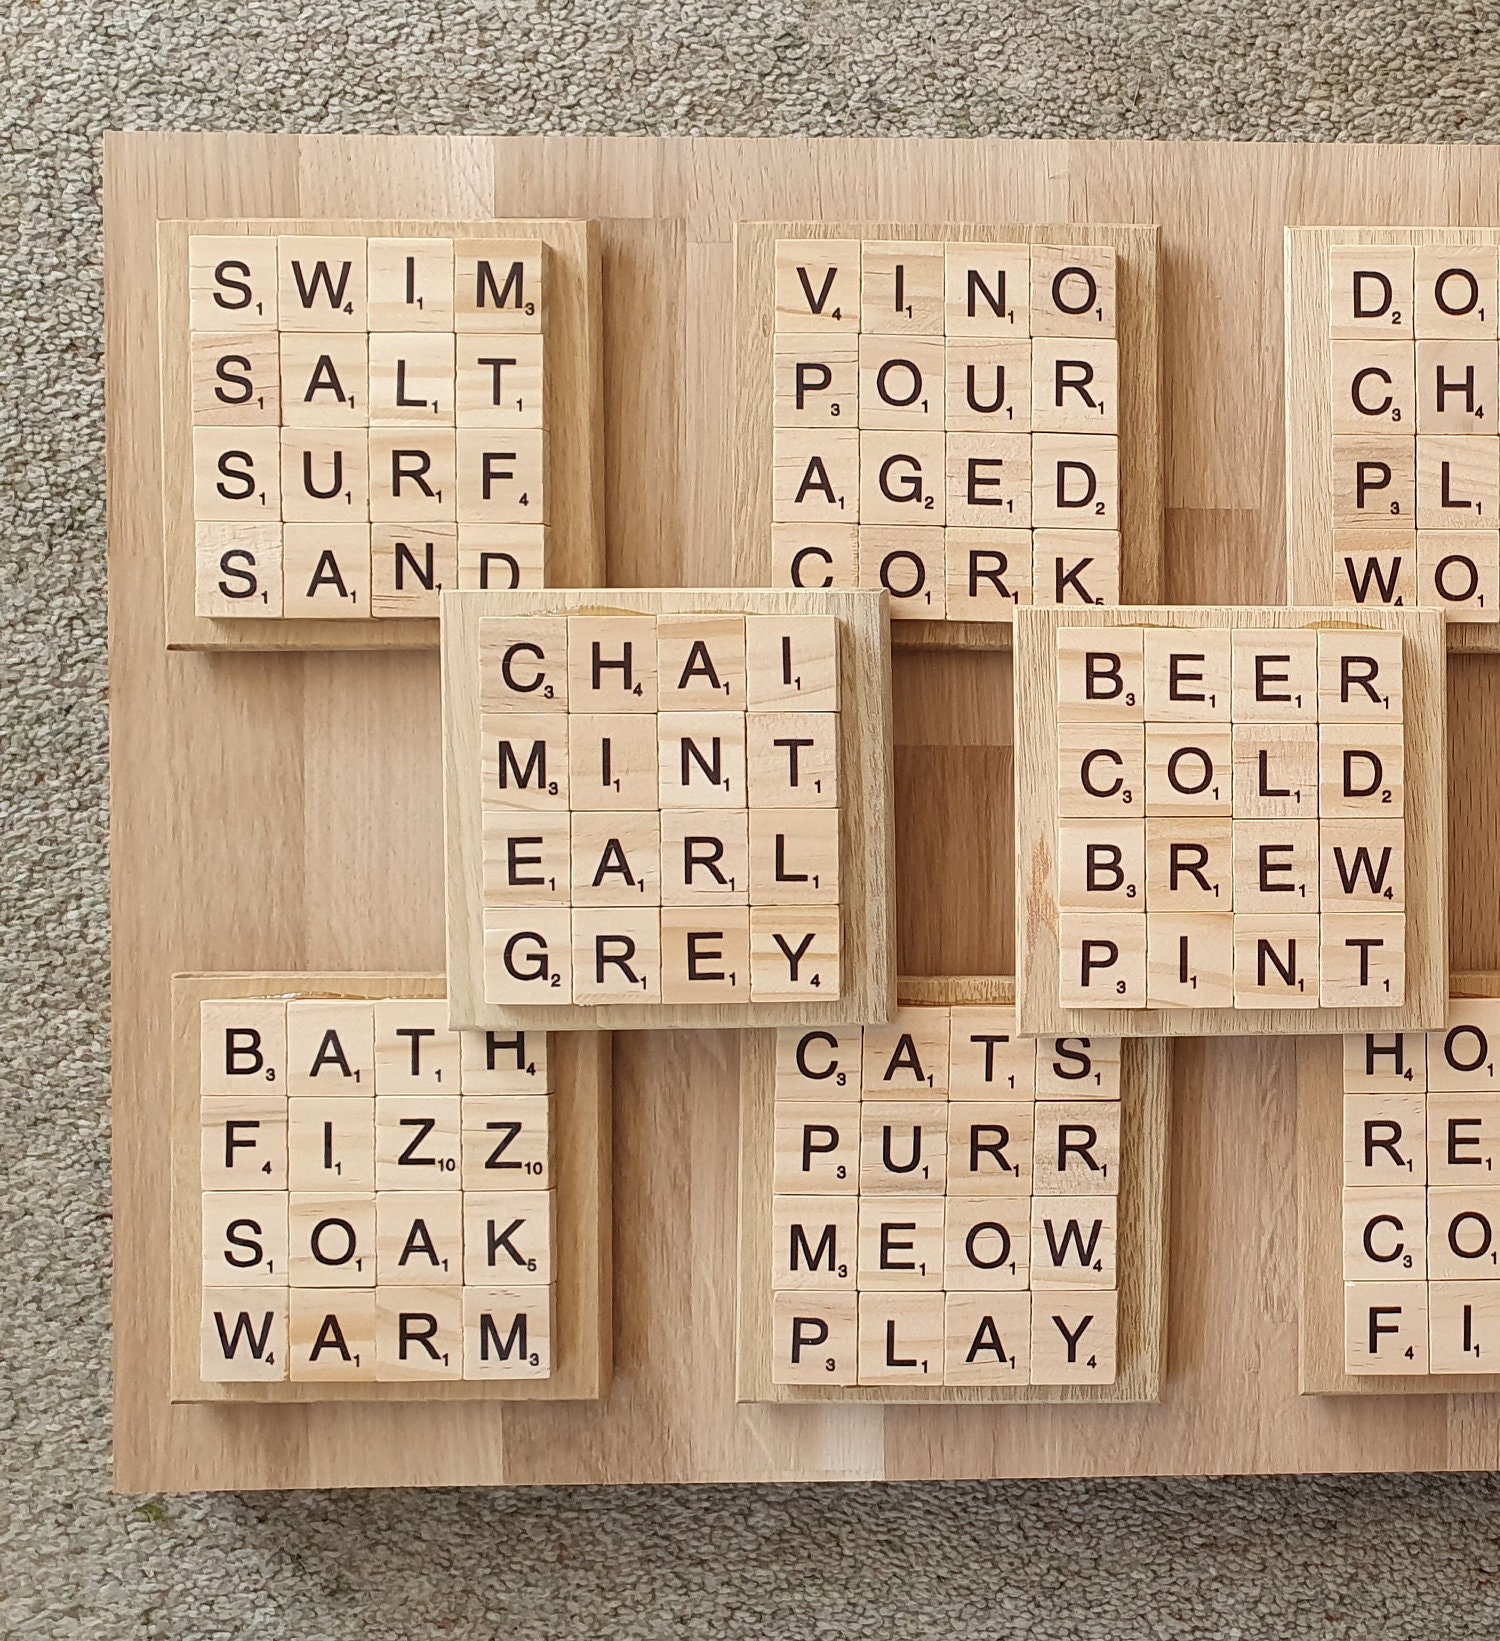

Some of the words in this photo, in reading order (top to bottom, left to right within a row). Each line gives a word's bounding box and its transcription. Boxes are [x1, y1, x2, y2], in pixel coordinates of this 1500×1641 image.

[212, 255, 525, 311] SWIM
[795, 263, 1098, 319] VINO
[213, 347, 518, 417] SALT
[794, 358, 1098, 415] POUR
[215, 448, 518, 501] SURF
[793, 452, 1098, 509] AGED
[217, 541, 521, 600] SAND
[789, 545, 1096, 605] CORK
[500, 635, 793, 694] CHAI
[1084, 651, 1383, 704] BEER
[497, 731, 815, 797] MINT
[1079, 742, 1384, 806] COLD
[506, 832, 810, 888] EARL
[1085, 838, 1393, 903] BREW
[502, 930, 817, 985] GREY
[1080, 934, 1385, 988] PINT
[224, 1027, 527, 1078] BATH
[794, 1026, 1093, 1088] CATS
[224, 1117, 524, 1170] FIZZ
[801, 1123, 1101, 1175] PURR
[223, 1216, 529, 1269] SOAK
[789, 1218, 1104, 1273] MEOW
[212, 1310, 528, 1363] WARM
[790, 1310, 1095, 1374] PLAY
